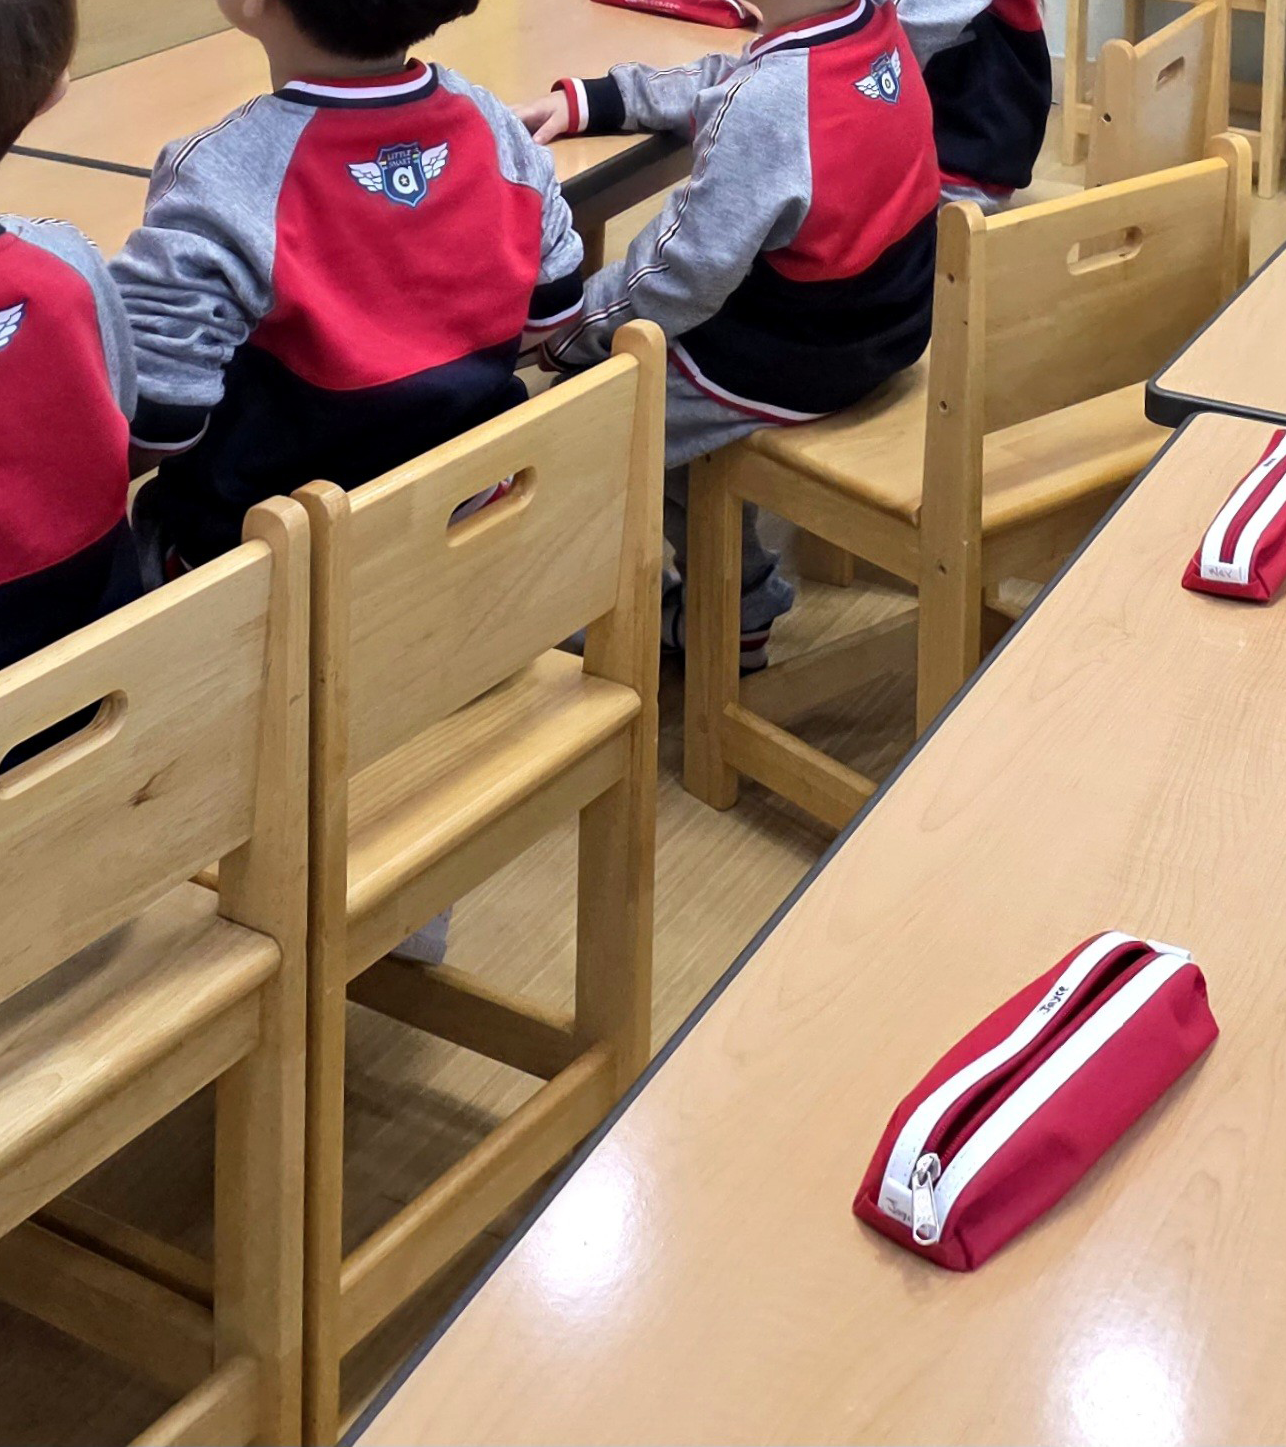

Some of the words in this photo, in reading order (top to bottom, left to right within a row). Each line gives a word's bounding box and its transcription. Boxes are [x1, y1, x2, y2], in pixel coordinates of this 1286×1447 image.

[386, 150, 411, 160] LITTLE
[389, 158, 411, 168] SMART
[1039, 985, 1069, 1014] Jayce
